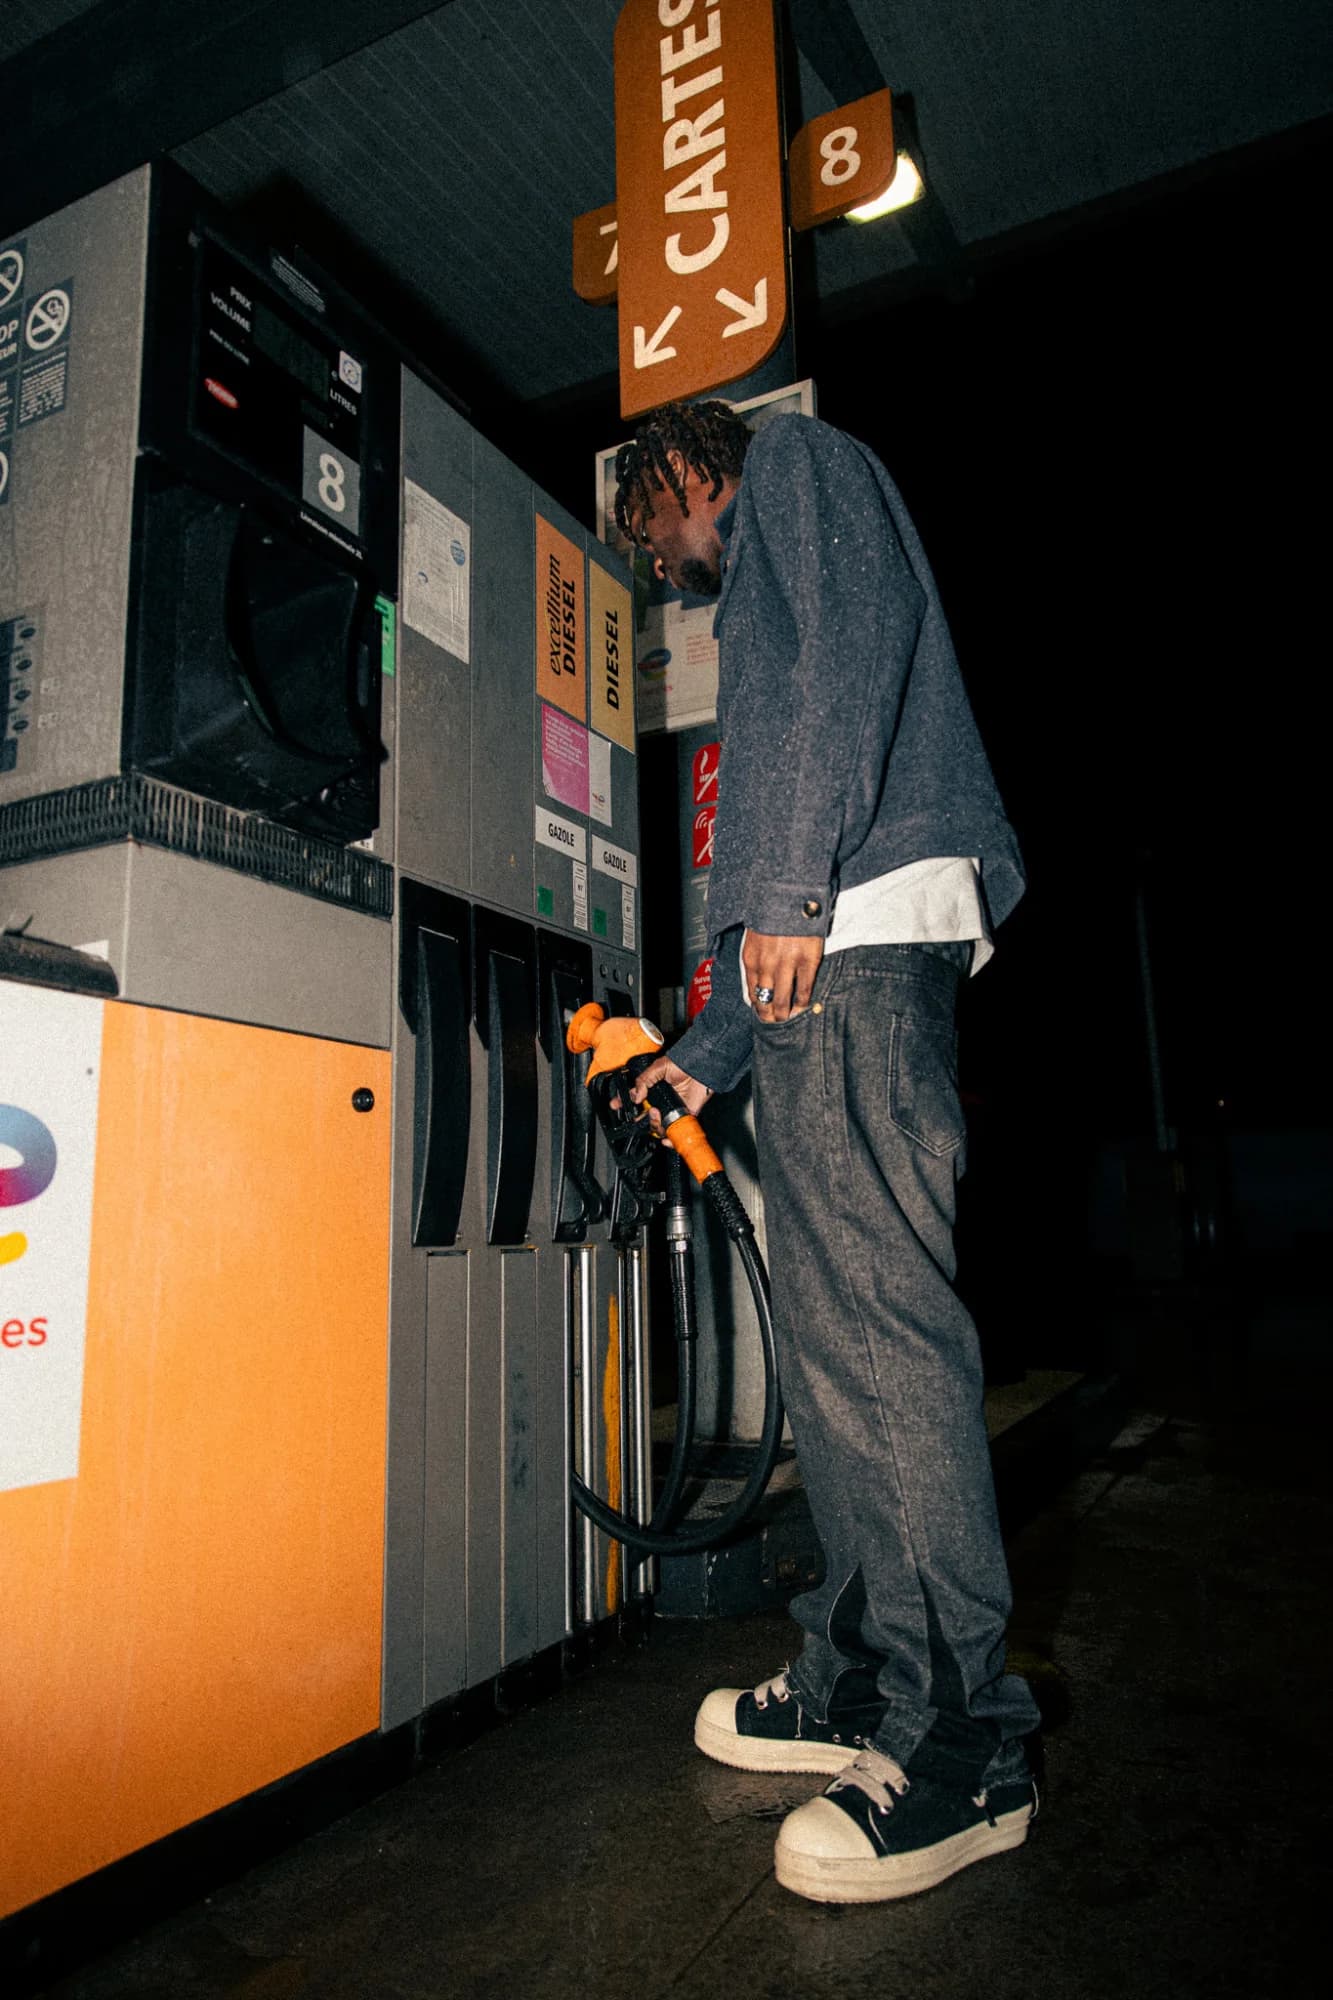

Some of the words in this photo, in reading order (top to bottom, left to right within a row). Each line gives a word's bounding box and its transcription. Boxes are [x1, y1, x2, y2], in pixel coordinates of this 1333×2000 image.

[819, 126, 861, 187] 8
[210, 291, 251, 332] VOLUME
[330, 388, 358, 416] LITRES
[318, 453, 345, 512] 8
[546, 554, 561, 676] excellium
[562, 579, 576, 676] DIESEL
[606, 610, 620, 710] DIESEL
[548, 823, 575, 847] GAZOLE
[603, 851, 627, 873] GAZOLE
[1, 1317, 48, 1348] es
